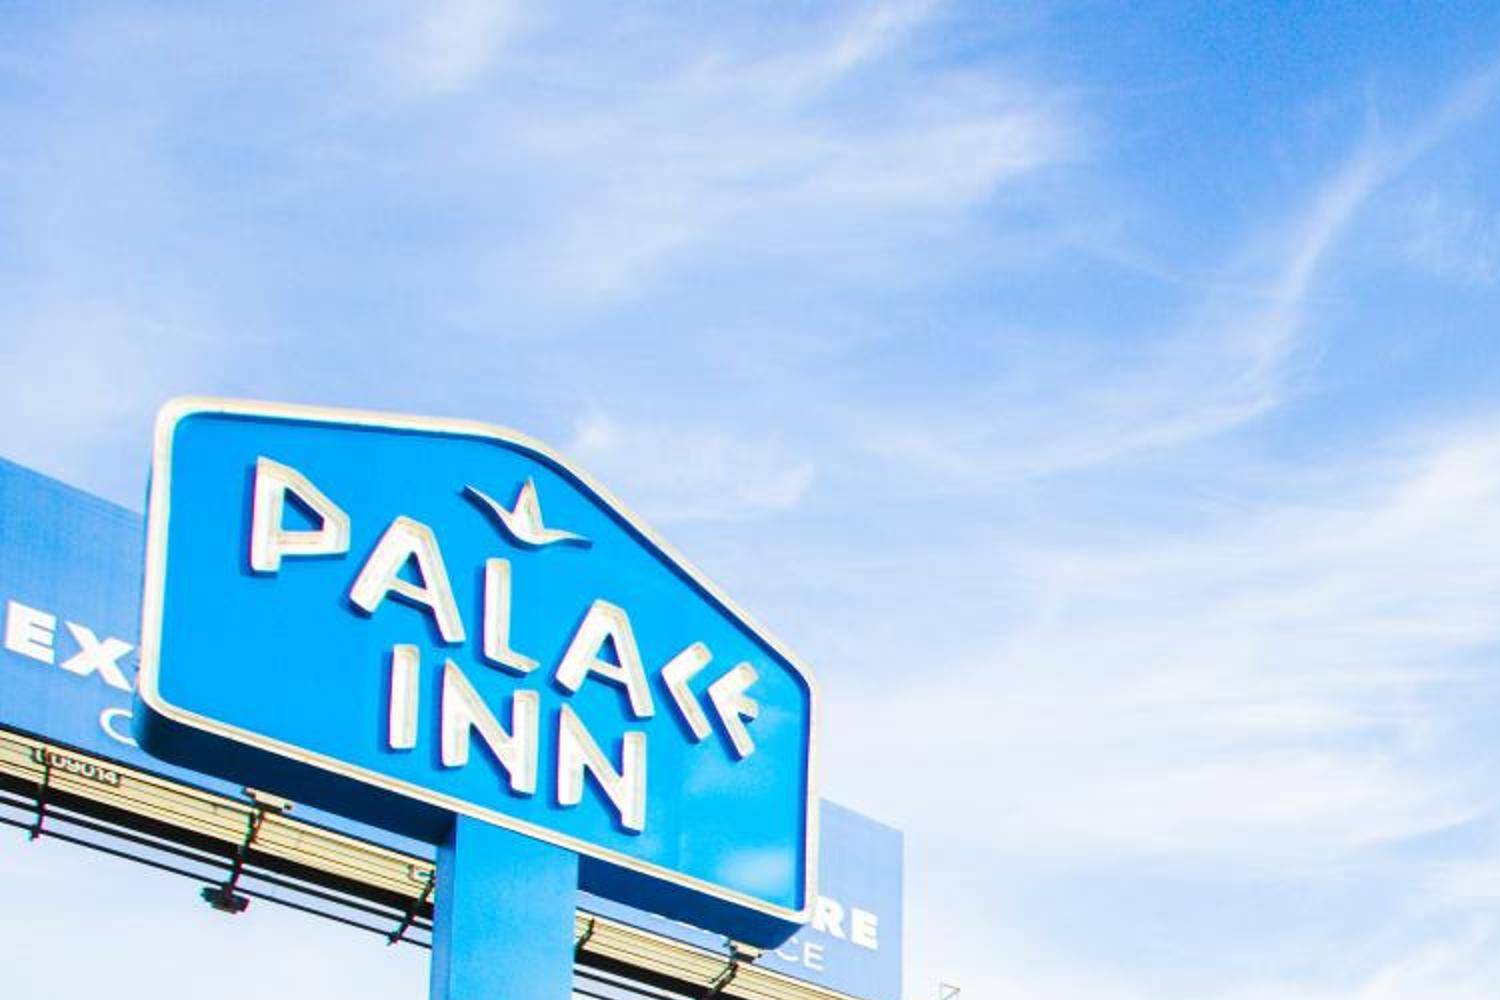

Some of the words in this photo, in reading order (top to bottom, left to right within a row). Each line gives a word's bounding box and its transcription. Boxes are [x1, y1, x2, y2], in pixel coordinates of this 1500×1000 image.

[250, 456, 761, 760] PALACE
[4, 599, 136, 694] EX
[812, 895, 881, 950] RE
[388, 643, 648, 833] INN
[775, 934, 826, 972] CE
